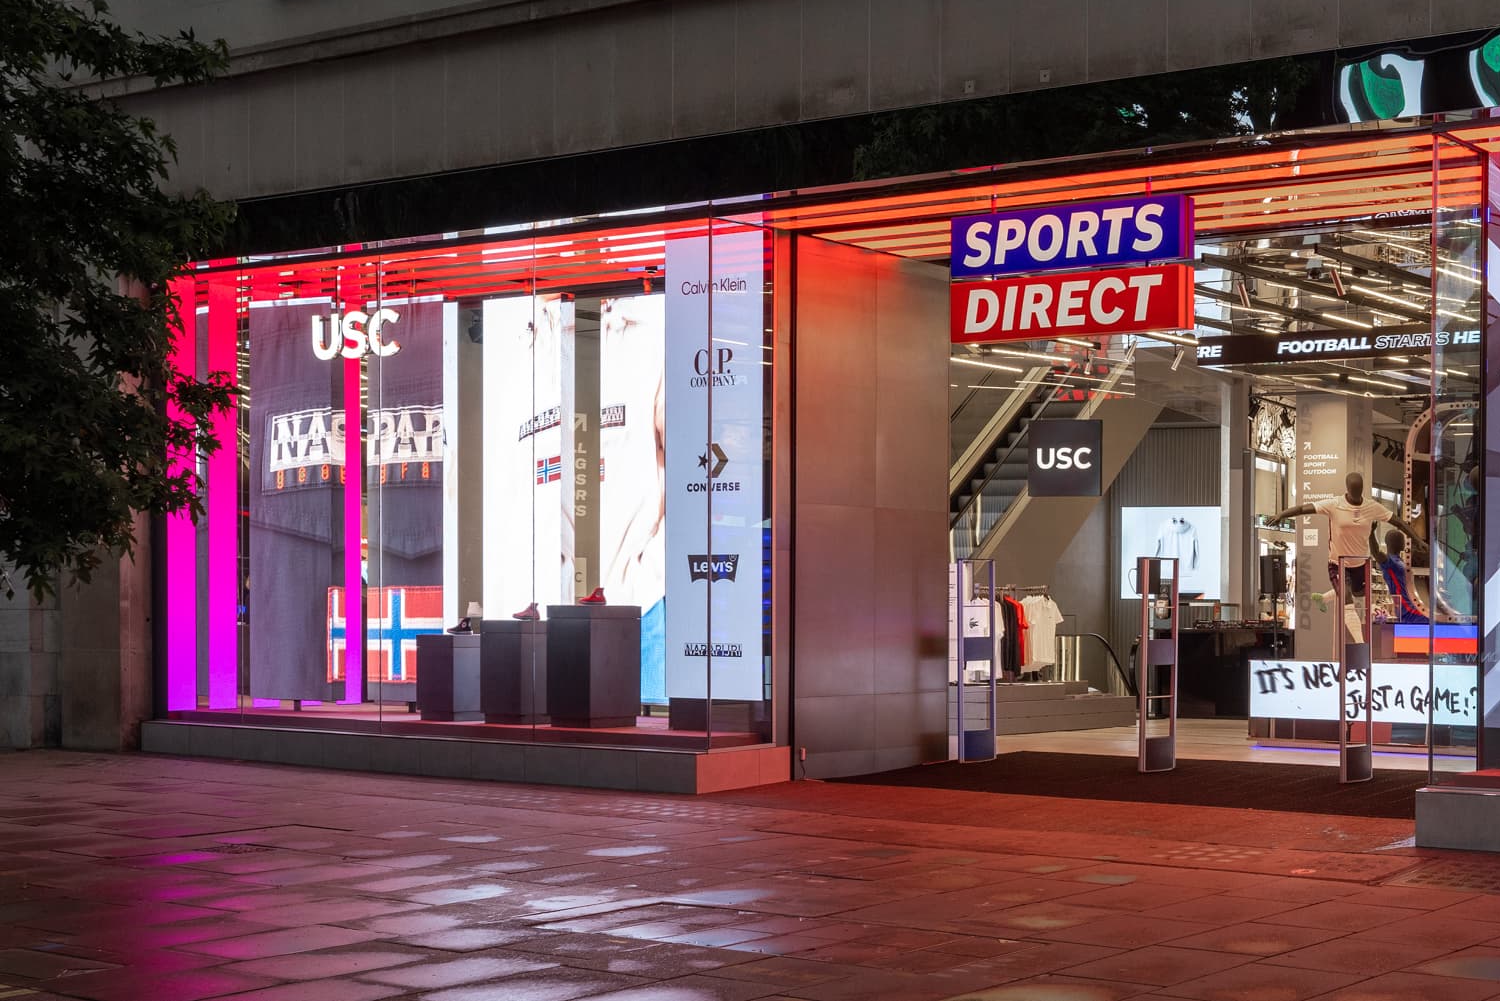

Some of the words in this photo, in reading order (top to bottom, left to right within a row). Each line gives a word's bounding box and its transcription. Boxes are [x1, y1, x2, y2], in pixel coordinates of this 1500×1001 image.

[963, 203, 1165, 268] SPORTS
[681, 280, 718, 296] Calvn
[720, 278, 747, 292] Klein
[964, 273, 1163, 334] DIRECT
[312, 308, 401, 360] USC
[1277, 336, 1372, 355] FOOTBALL
[1374, 331, 1450, 349] STARTS
[1036, 446, 1092, 470] USC
[1254, 661, 1296, 694] IT'S
[1394, 690, 1405, 709] A
